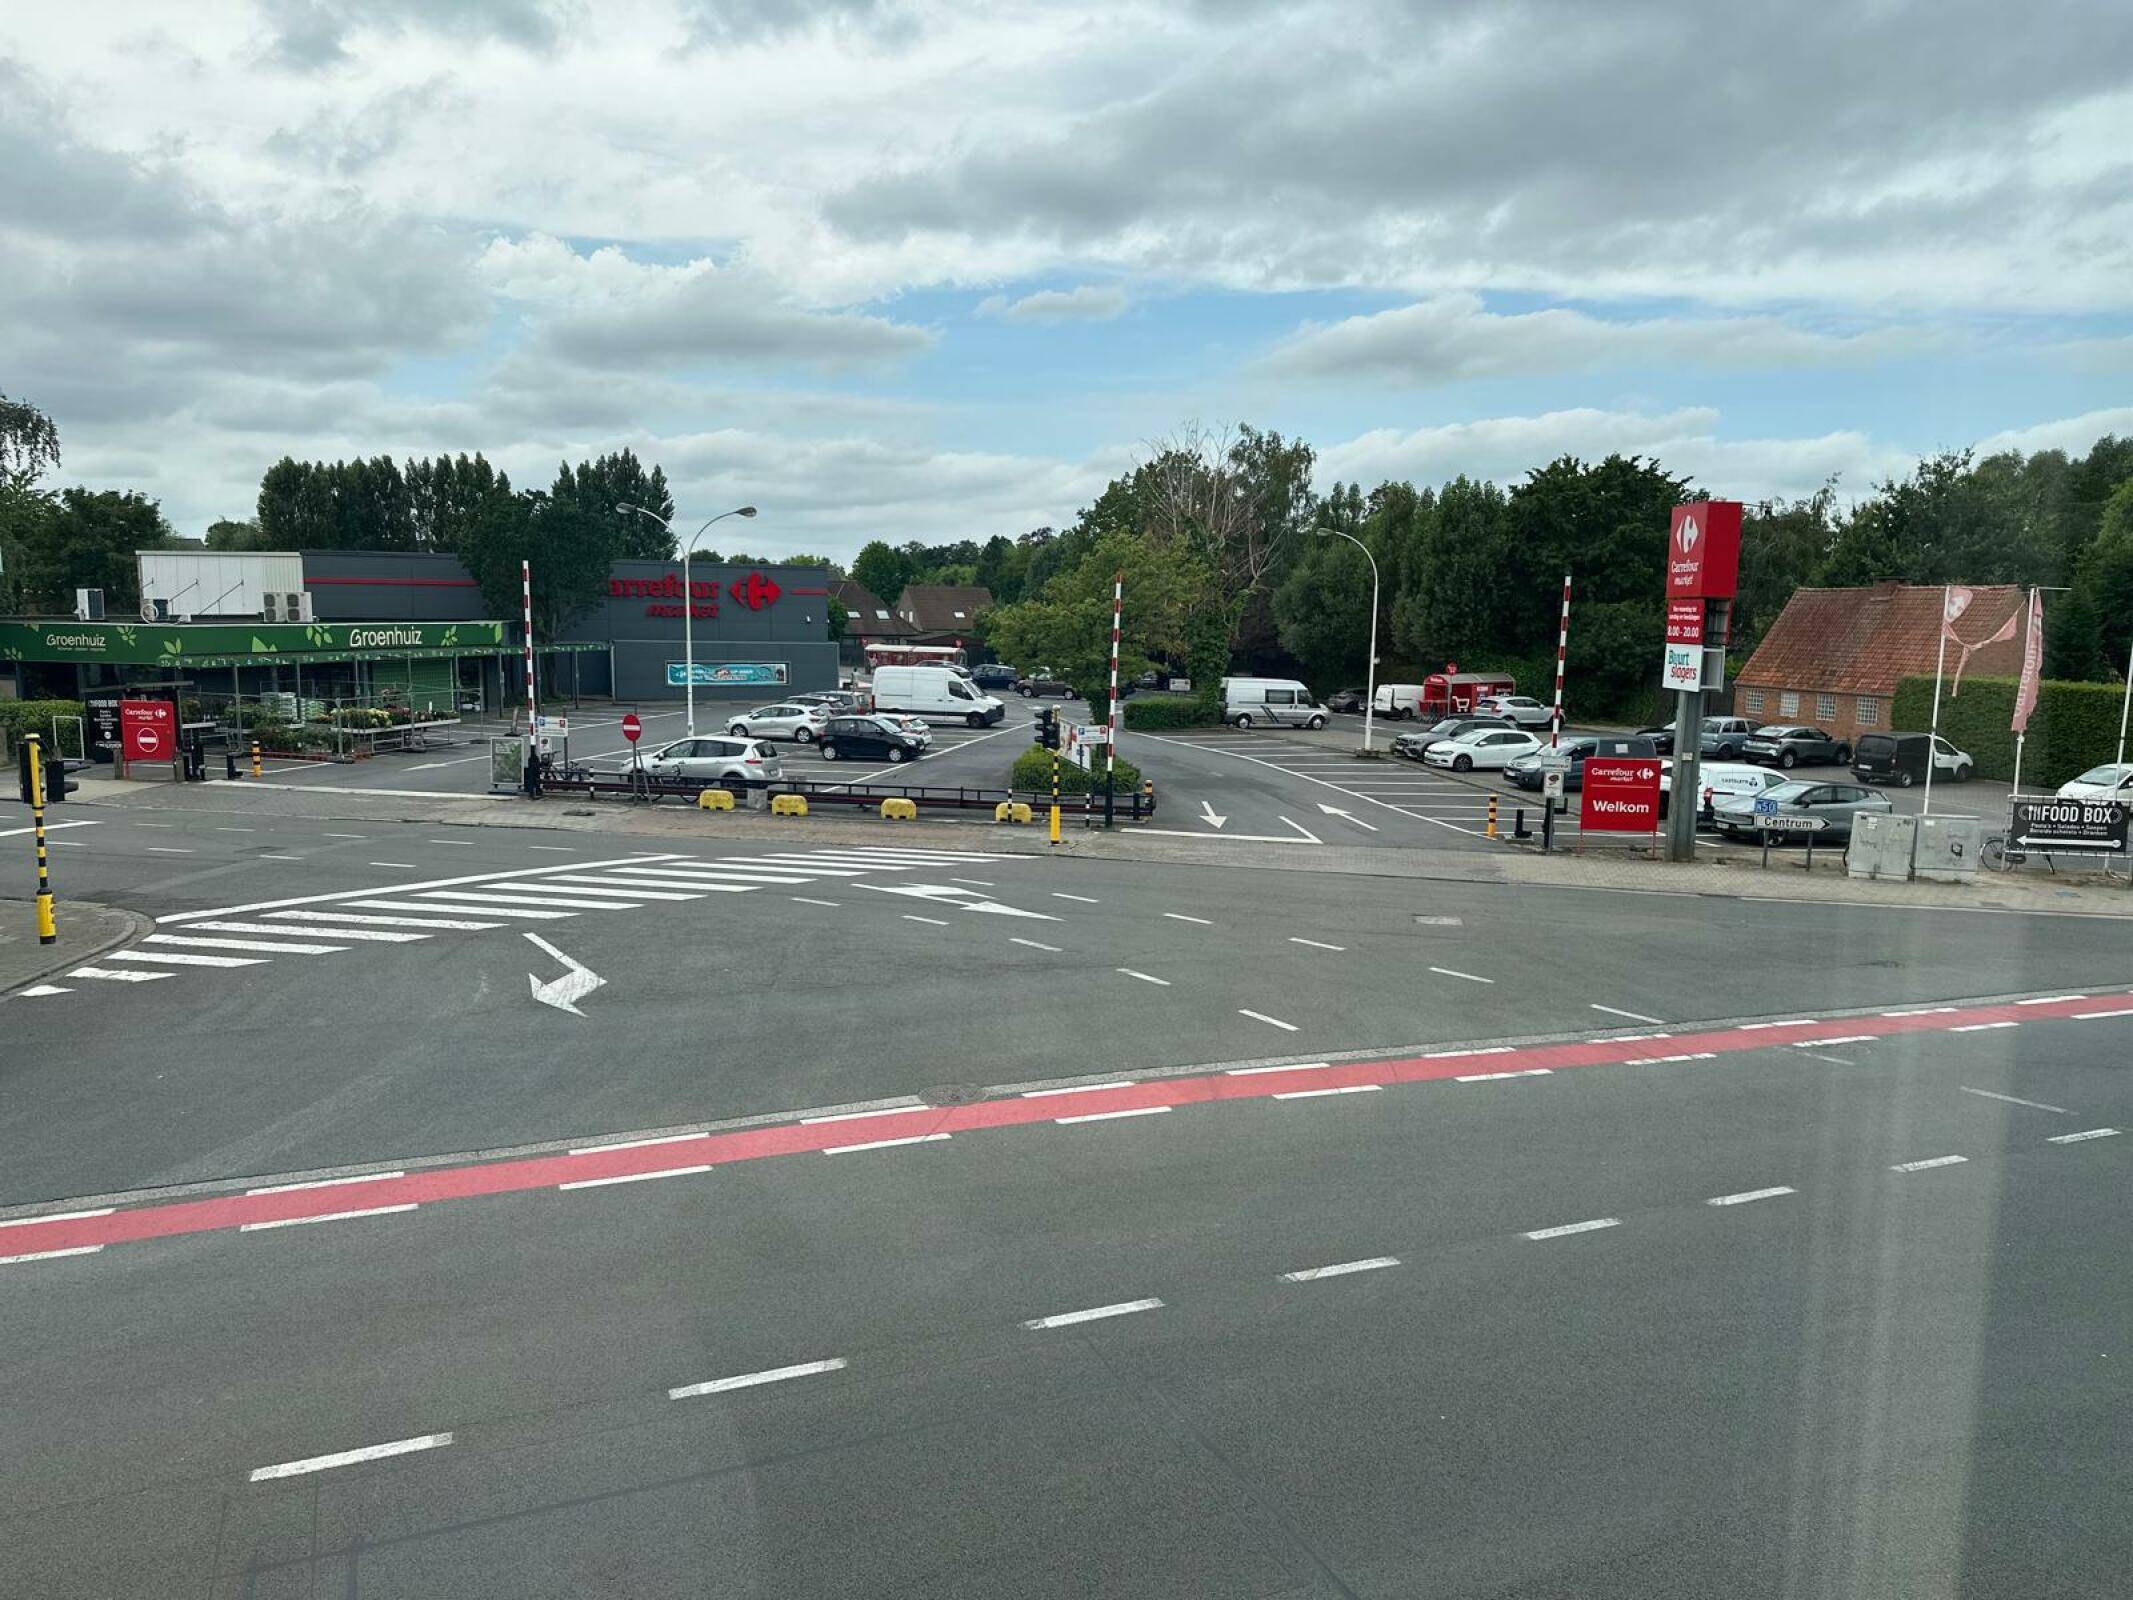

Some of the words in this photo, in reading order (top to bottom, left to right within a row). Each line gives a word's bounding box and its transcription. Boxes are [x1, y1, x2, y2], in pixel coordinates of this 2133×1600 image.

[1671, 560, 1699, 573] Carrefour
[609, 573, 719, 599] arrefour
[46, 633, 106, 647] Groenhuiz
[350, 626, 423, 648] Groenhuiz
[1669, 650, 1689, 665] Buurt
[1671, 664, 1697, 683] slagers
[1592, 767, 1634, 776] Carrefour
[1593, 799, 1649, 813] Welkom
[2042, 807, 2079, 821] FOOD
[2084, 807, 2112, 823] BOX
[1764, 816, 1813, 829] Centrum
